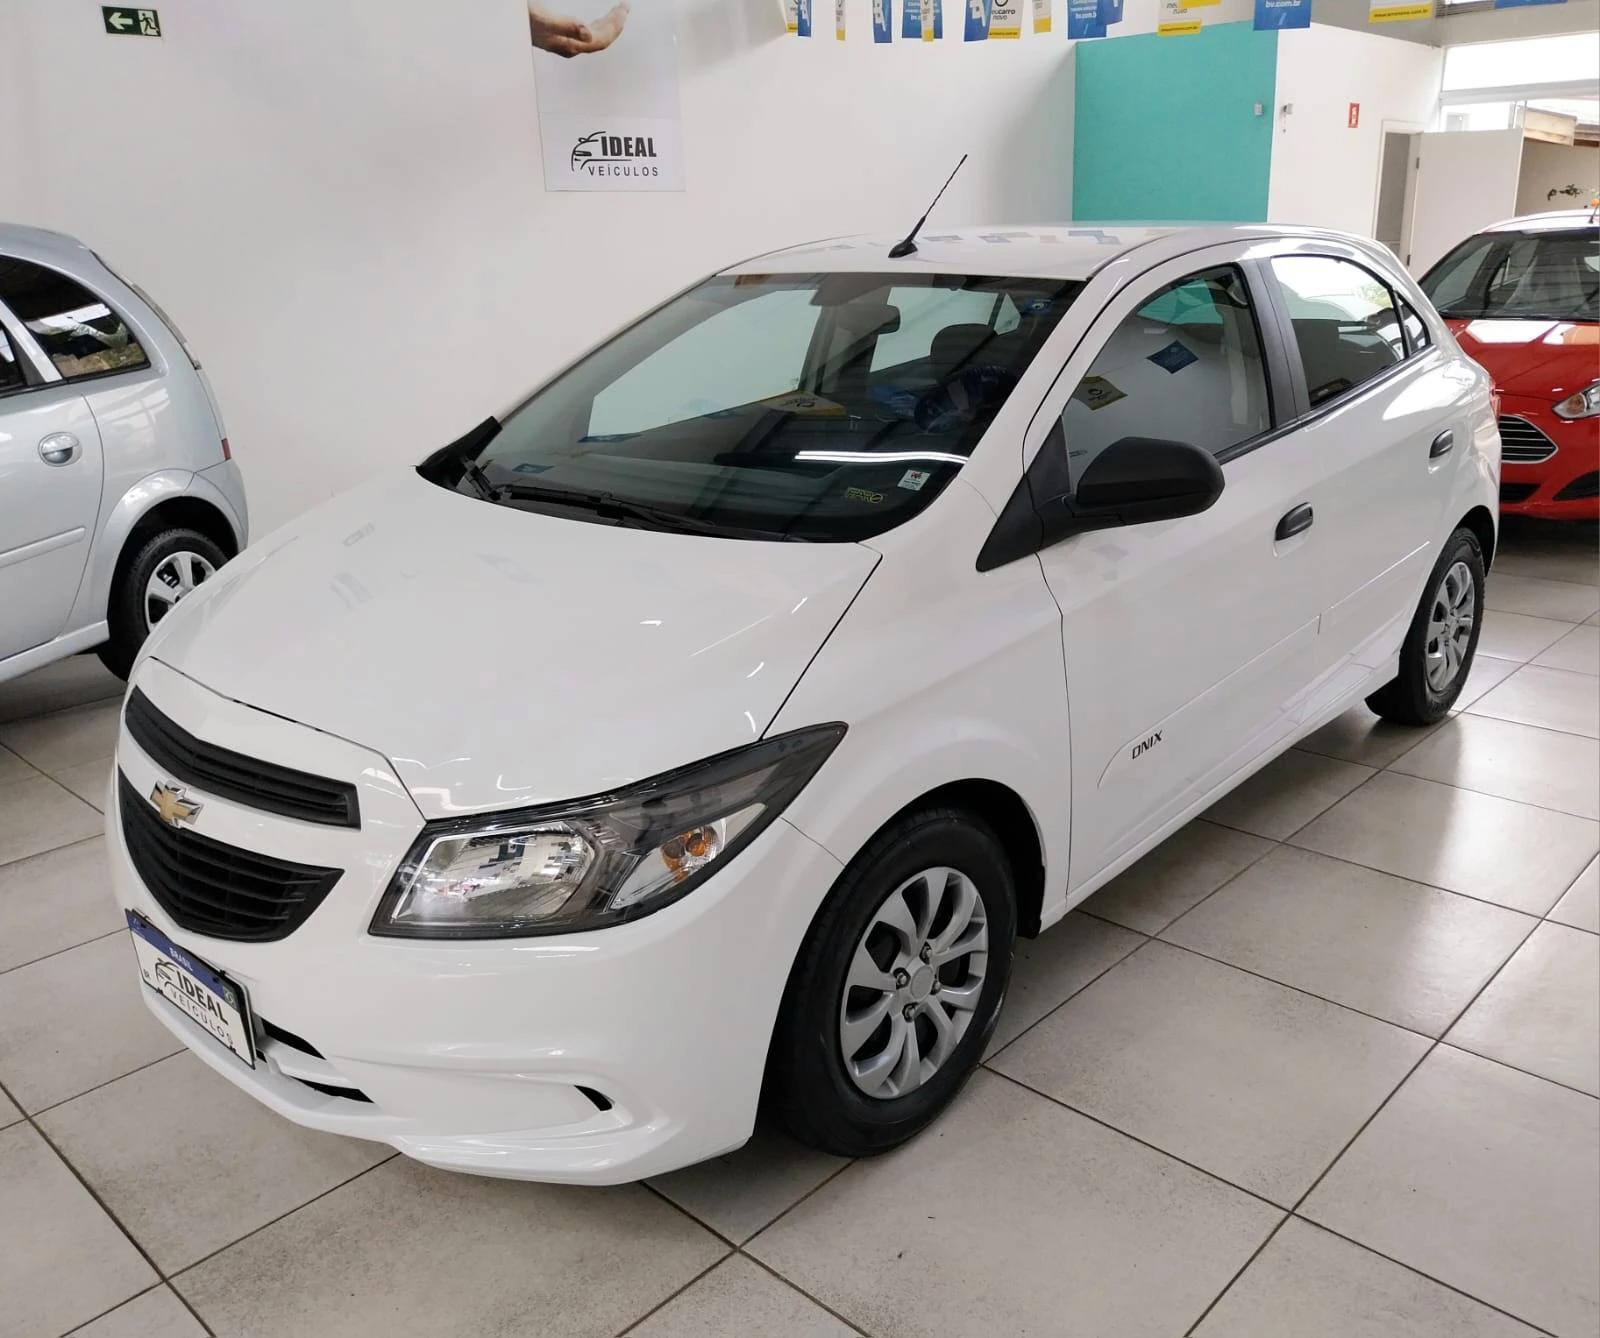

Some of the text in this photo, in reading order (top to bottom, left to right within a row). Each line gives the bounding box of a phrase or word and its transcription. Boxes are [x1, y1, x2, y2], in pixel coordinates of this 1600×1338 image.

[601, 136, 657, 157] IDEAL
[588, 164, 659, 177] VEÍCULOS
[1132, 730, 1162, 760] ONIX
[168, 947, 193, 972] BRASIL
[175, 970, 230, 1026] IDEAL
